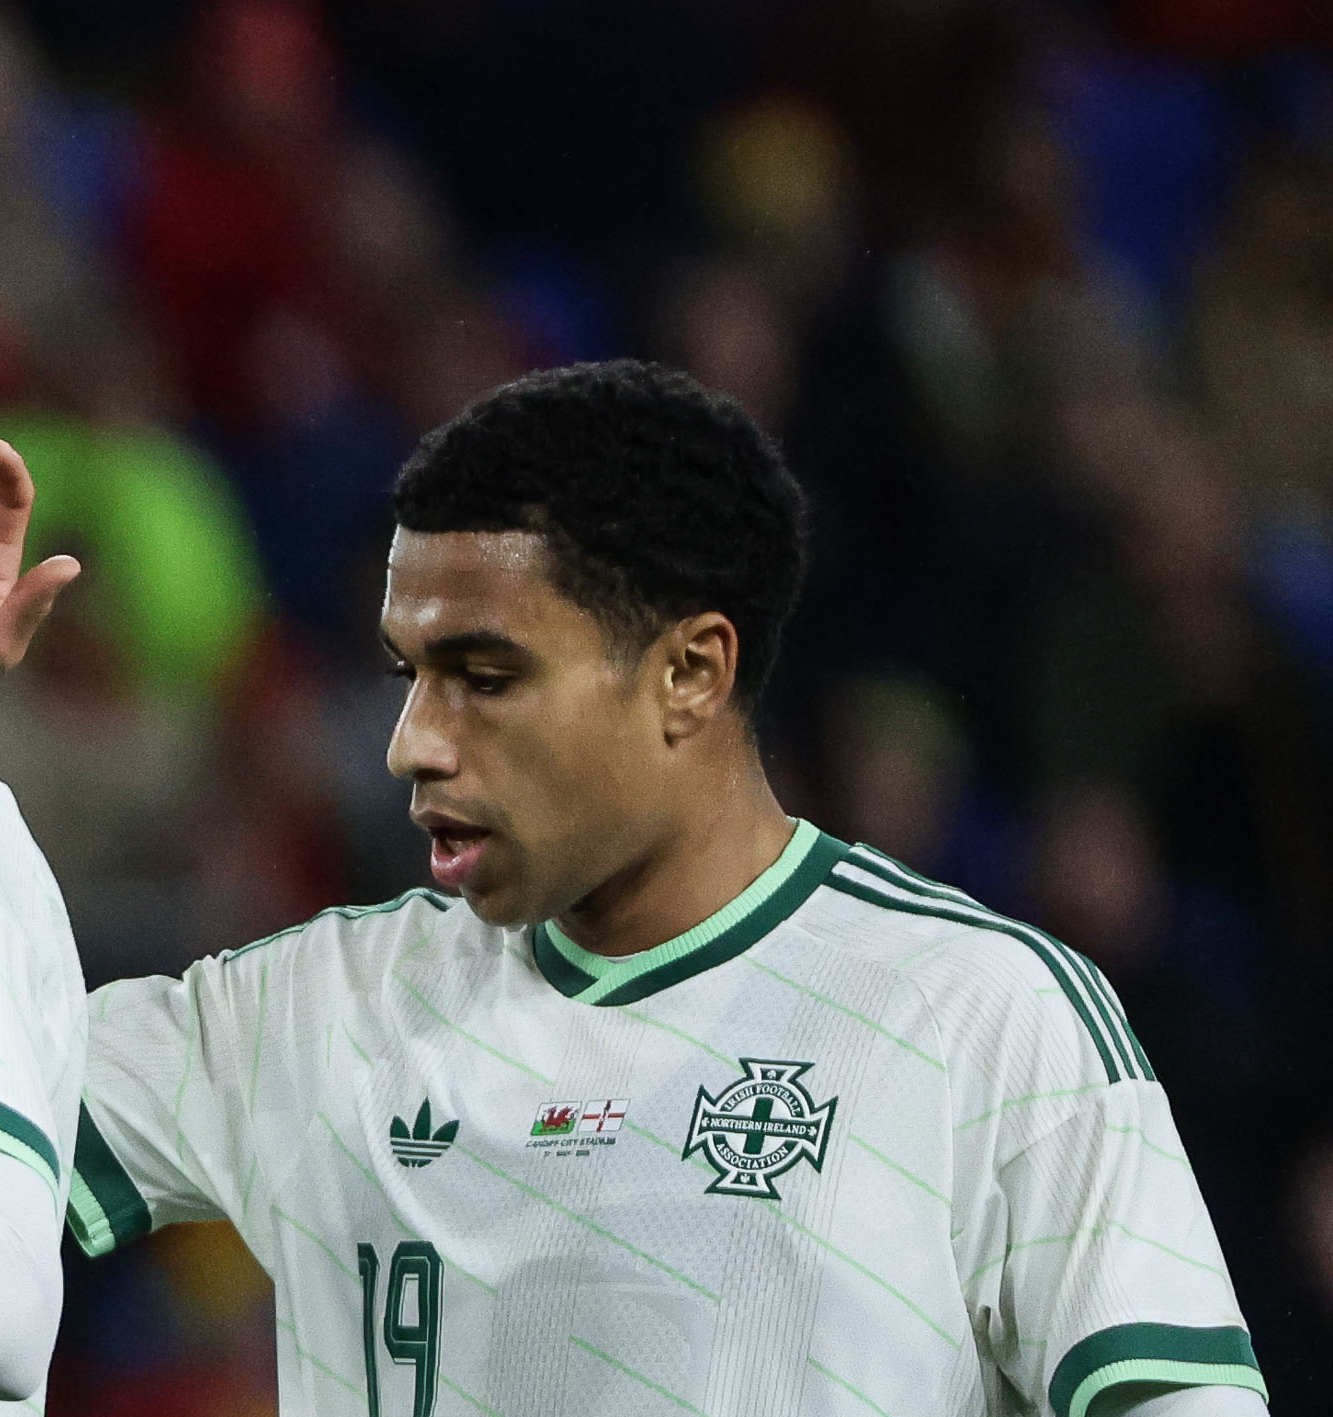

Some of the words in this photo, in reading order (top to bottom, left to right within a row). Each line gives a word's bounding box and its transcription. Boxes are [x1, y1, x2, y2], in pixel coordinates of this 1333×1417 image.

[724, 1086, 754, 1110] IRISH
[756, 1083, 801, 1116] FOOTBALL
[710, 1117, 763, 1131] NORTHERN
[763, 1122, 807, 1135] IRELAND
[716, 1142, 790, 1169] ASSOCIATION
